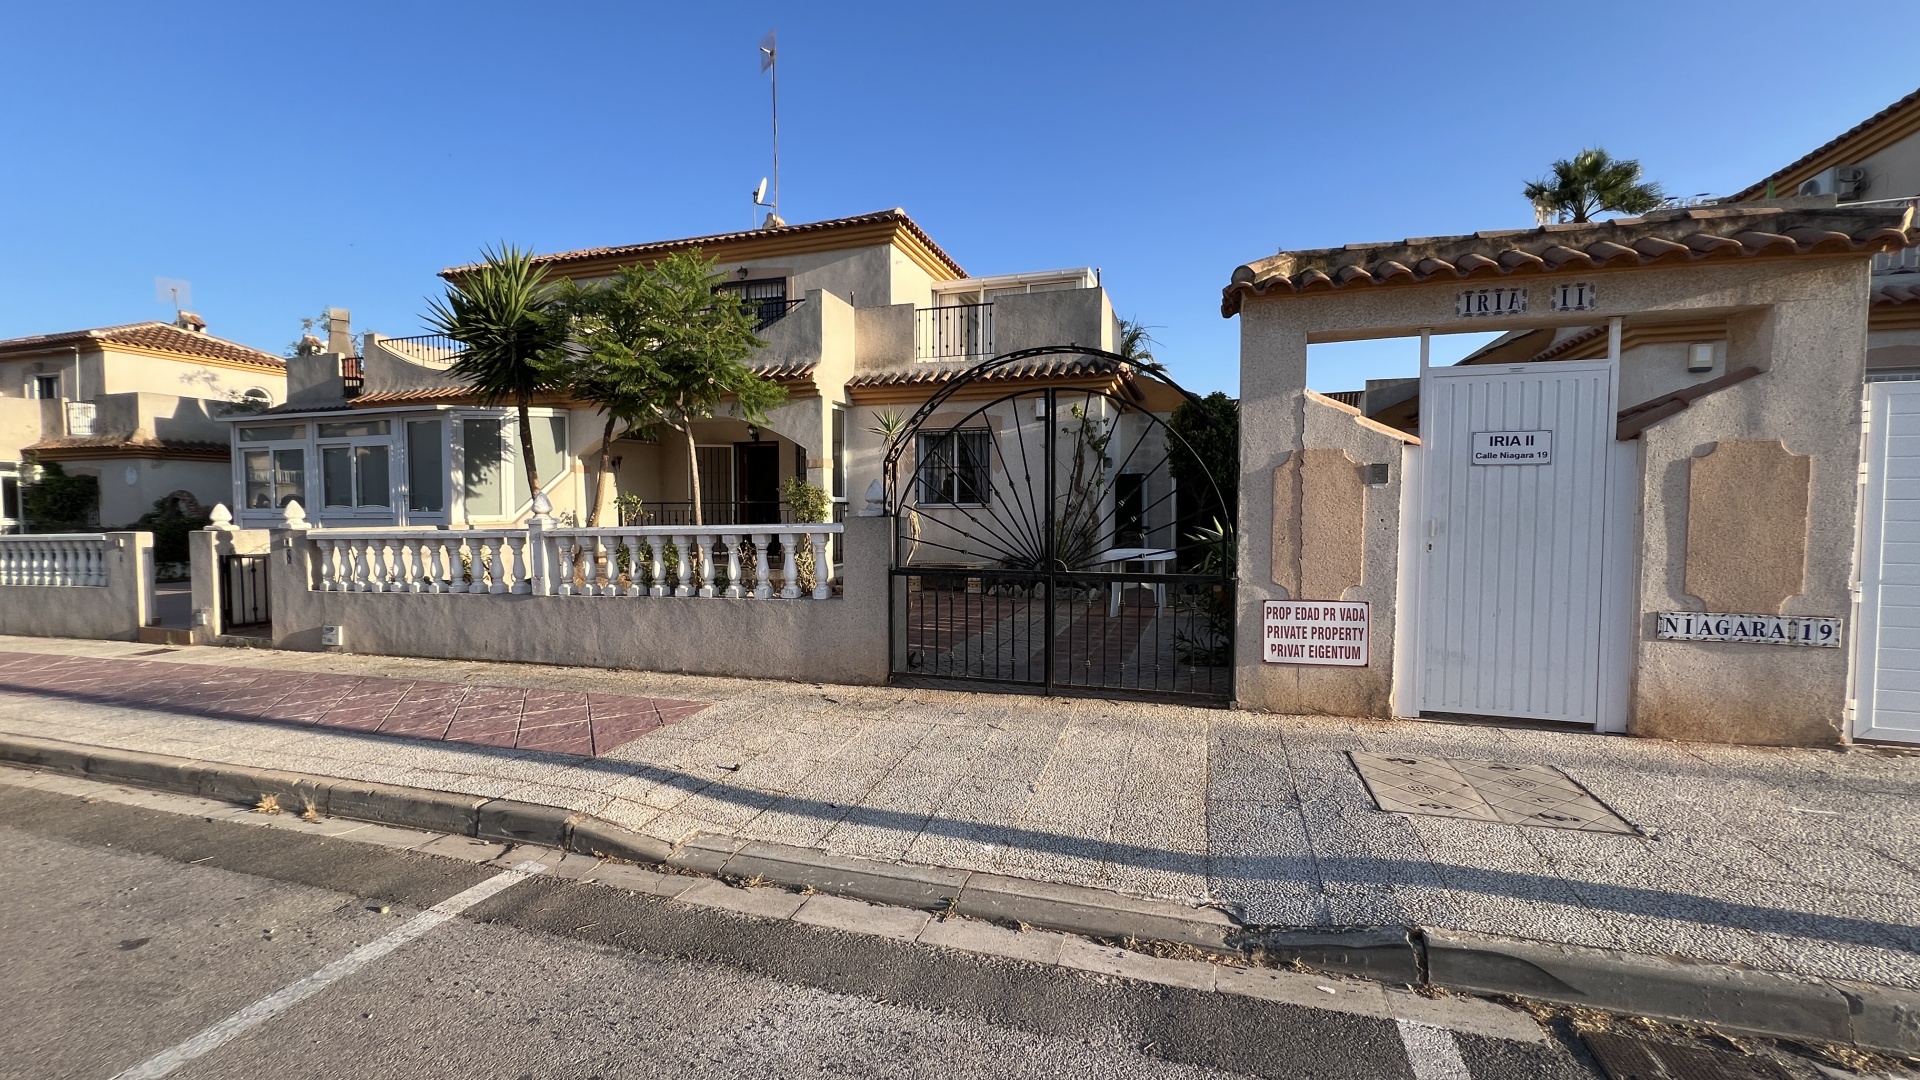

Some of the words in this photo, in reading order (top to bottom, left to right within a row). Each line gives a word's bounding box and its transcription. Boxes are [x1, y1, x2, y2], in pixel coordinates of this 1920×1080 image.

[1465, 292, 1521, 312] IRIA
[1561, 287, 1585, 306] II
[1489, 435, 1521, 447] IRIA
[1525, 435, 1535, 446] II
[1500, 452, 1534, 460] Niagara
[1266, 606, 1320, 620] PROPEDAD
[1323, 607, 1366, 622] PRVADA
[1267, 625, 1307, 639] PRIVATE
[1311, 626, 1364, 641] PROPERTY
[1664, 617, 1786, 639] NIAGARA
[1802, 623, 1833, 641] 19
[1270, 643, 1305, 657] PRIVAT
[1308, 644, 1361, 659] EIGENTUM
